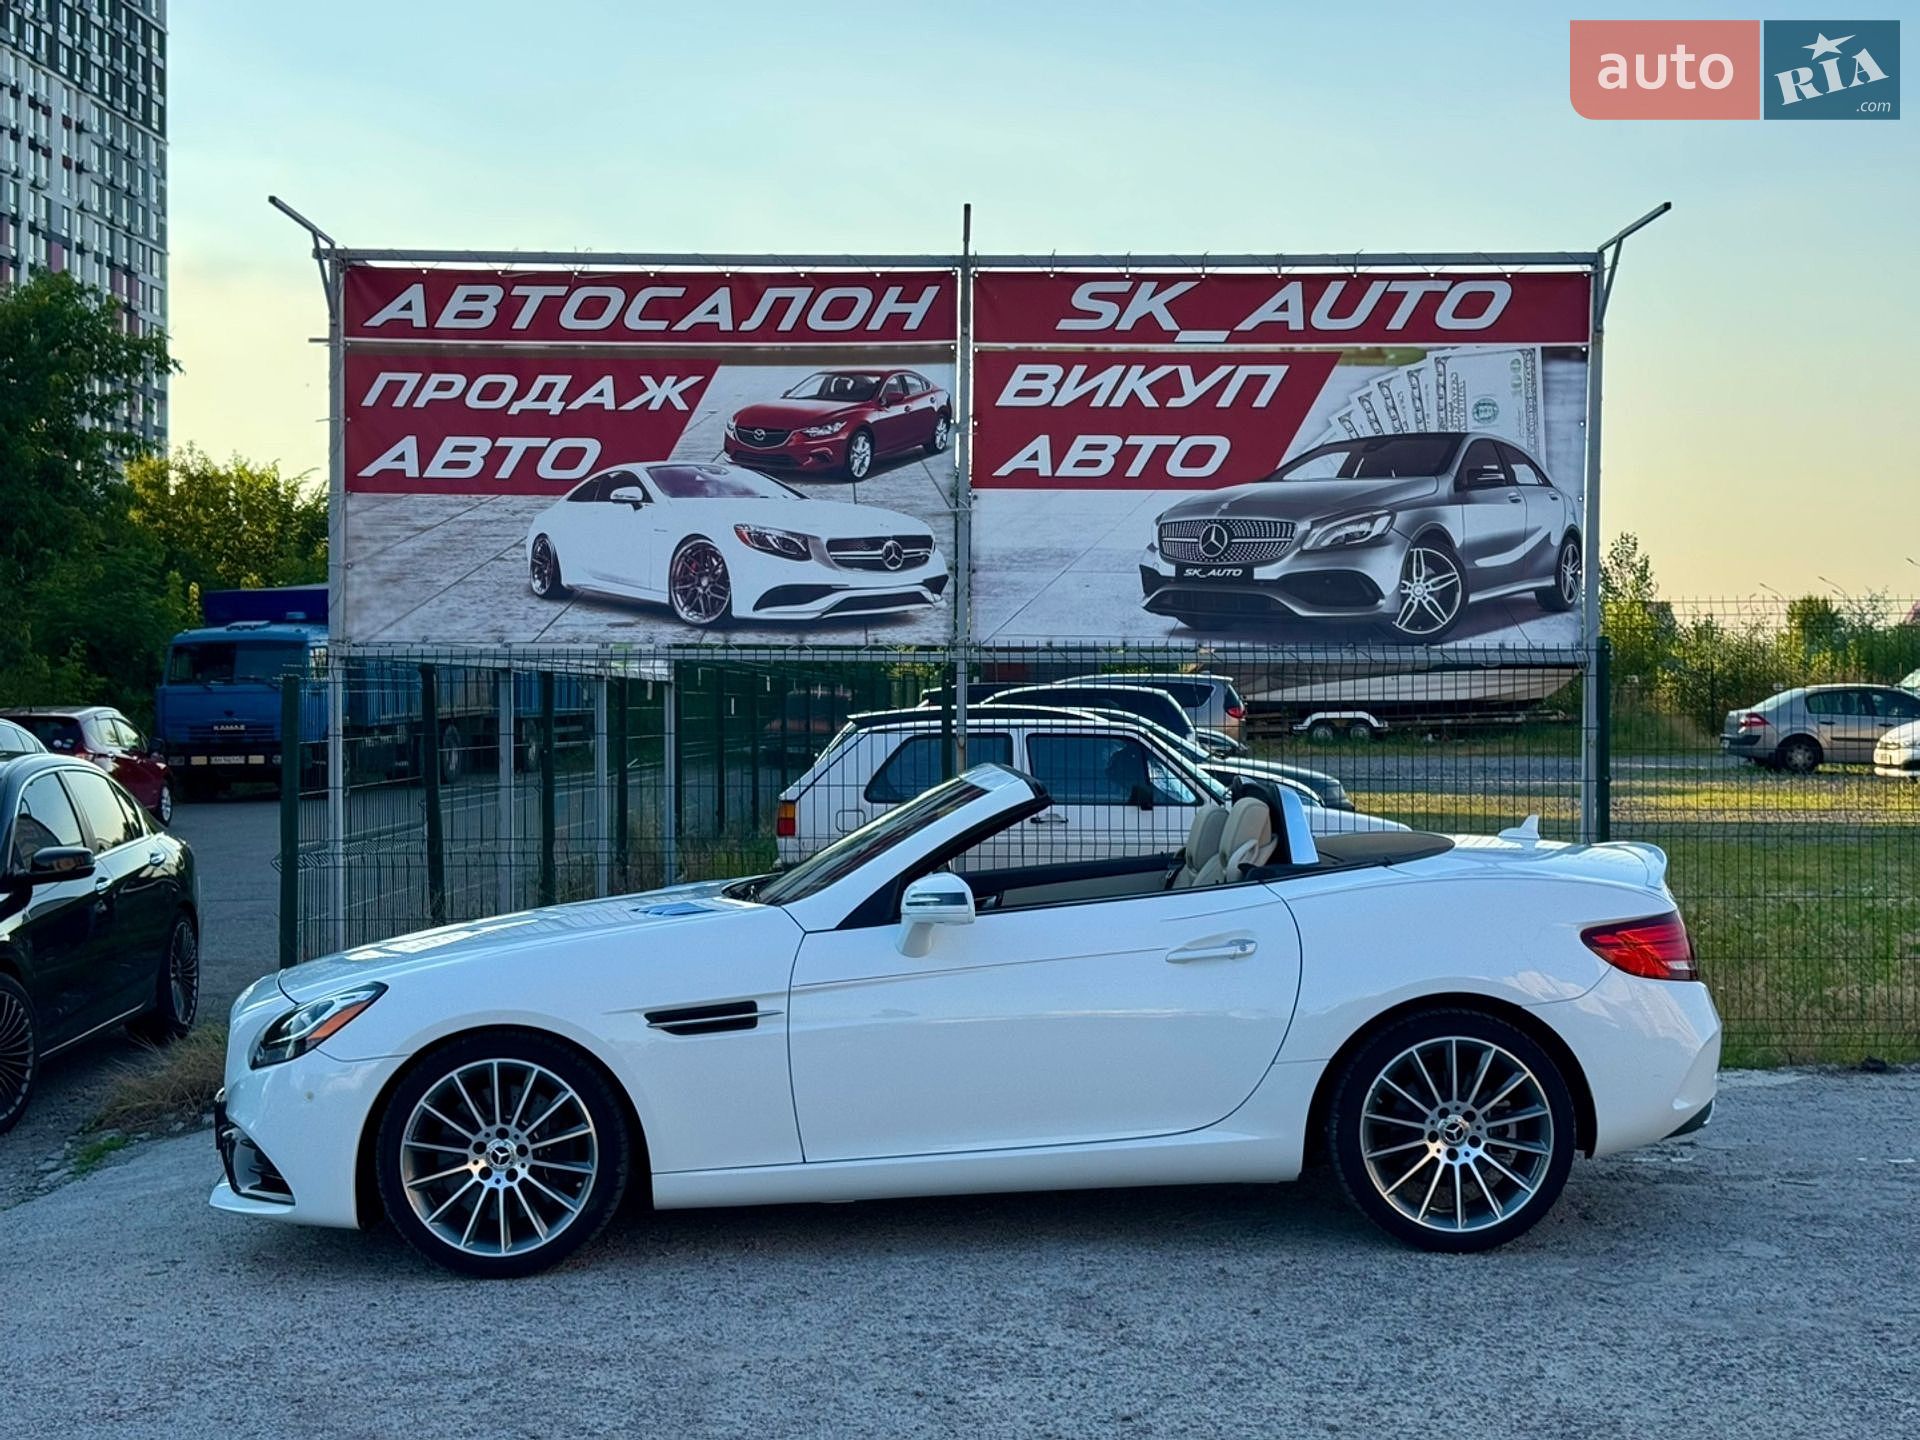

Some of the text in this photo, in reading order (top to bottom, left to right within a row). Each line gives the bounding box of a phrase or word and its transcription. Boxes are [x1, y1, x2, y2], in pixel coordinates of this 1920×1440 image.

[363, 282, 941, 332] АВТОСАЛОН
[1055, 279, 1513, 343] SK_AUTO
[360, 371, 705, 416] ПРОДАЖ
[994, 363, 1291, 409] ВИКУП
[356, 435, 602, 481] АВТО
[991, 433, 1231, 479] АВТО
[1183, 567, 1244, 579] SK_AUTO
